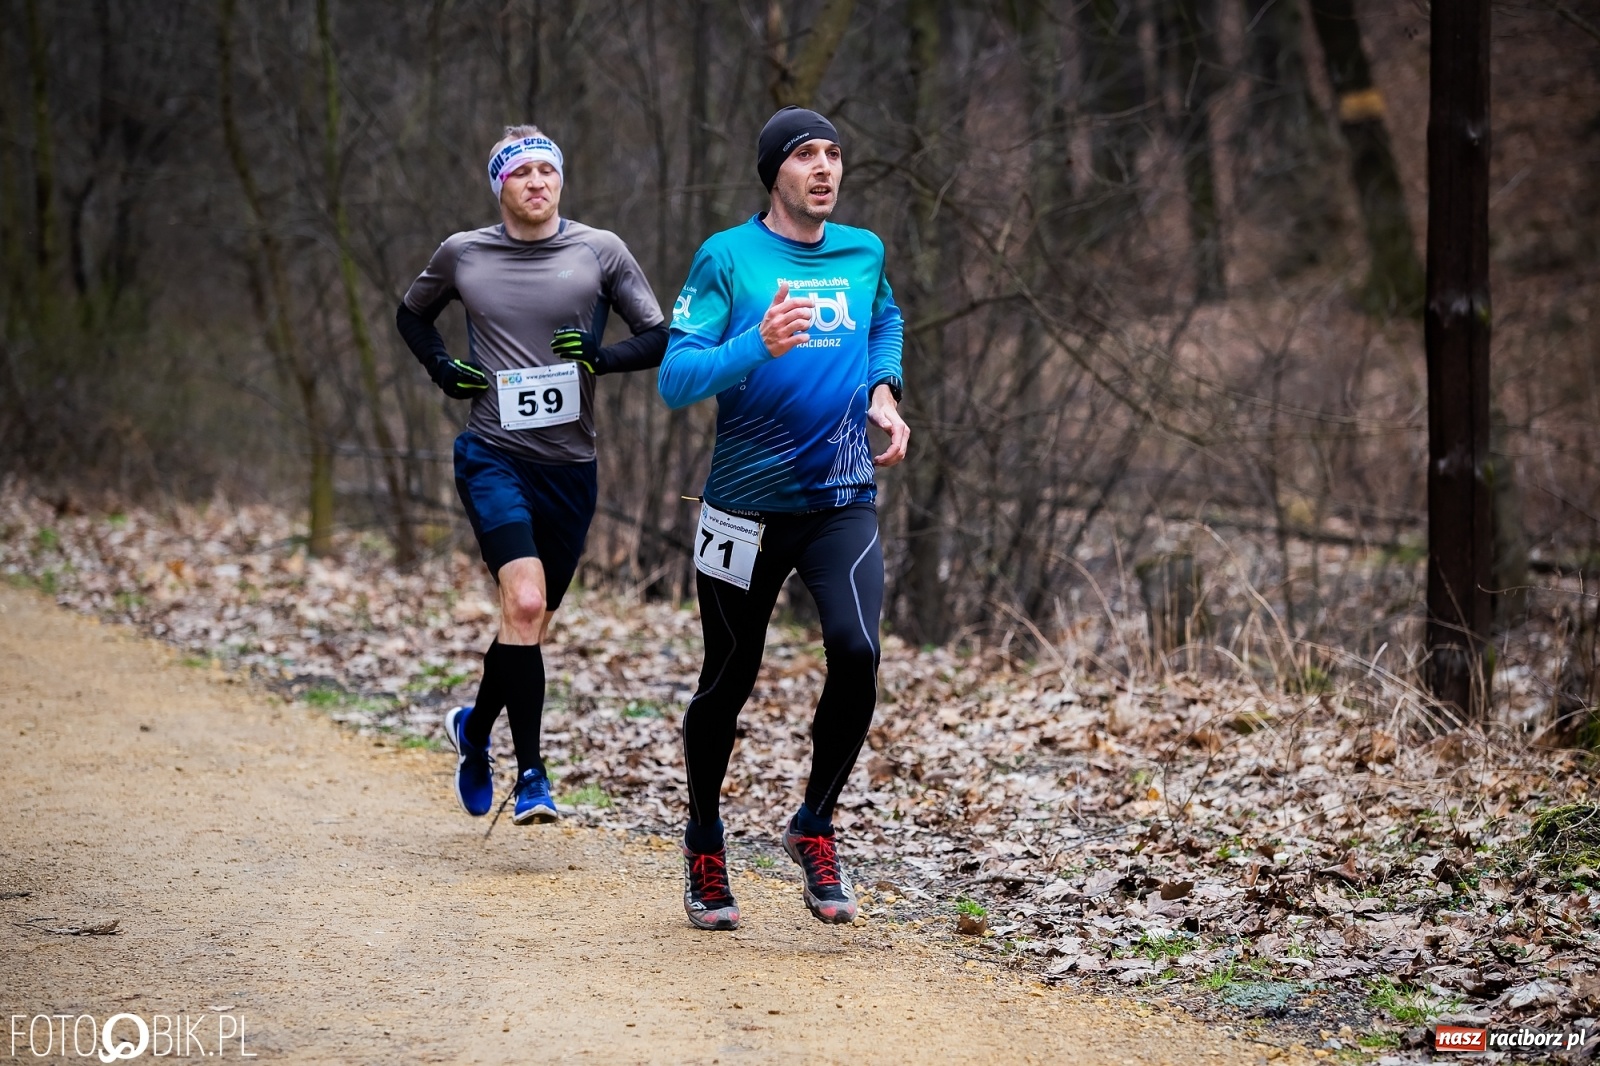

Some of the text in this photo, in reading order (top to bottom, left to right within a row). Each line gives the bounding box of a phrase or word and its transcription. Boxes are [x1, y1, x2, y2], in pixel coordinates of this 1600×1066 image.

[518, 387, 563, 416] 59
[709, 515, 759, 537] www.personalbest.pl
[699, 526, 735, 570] 71
